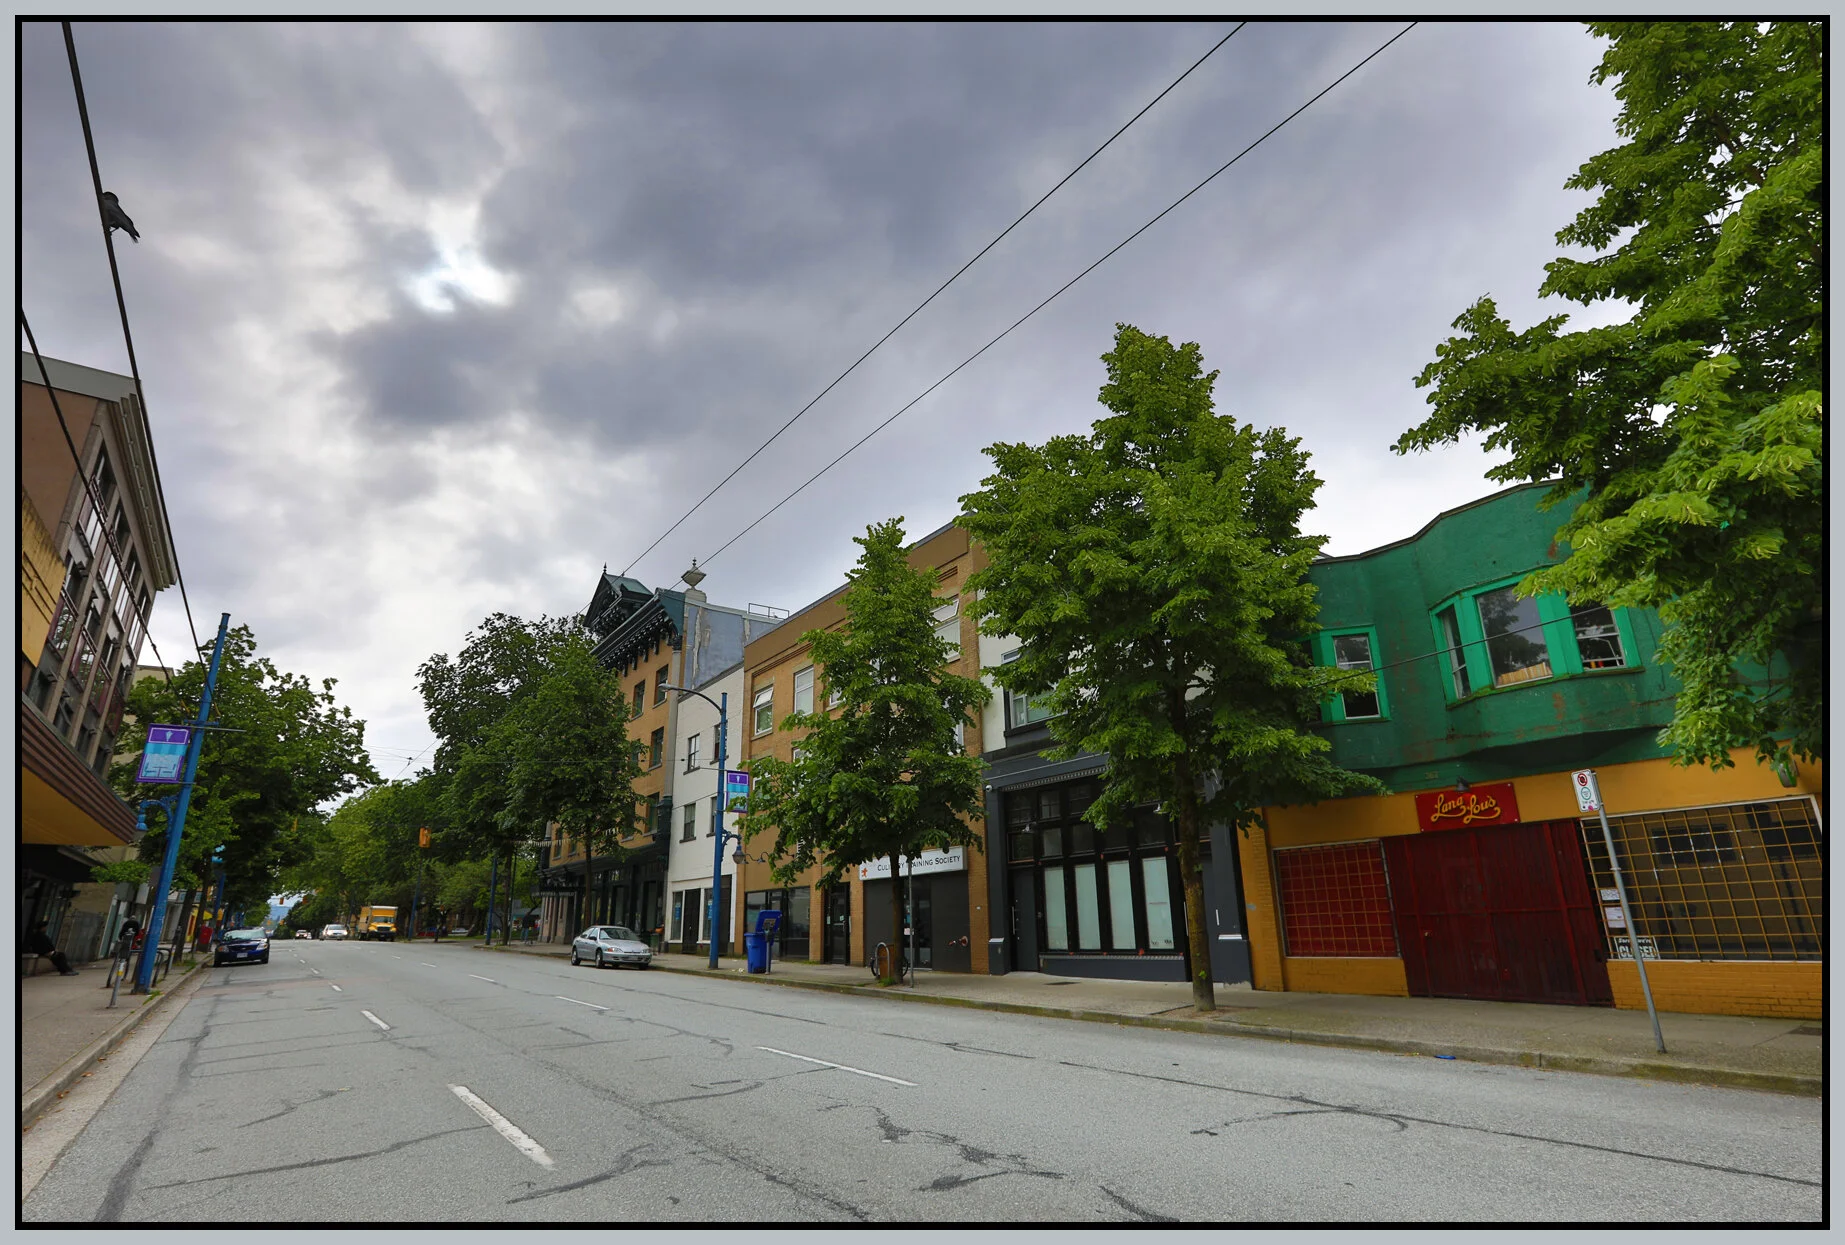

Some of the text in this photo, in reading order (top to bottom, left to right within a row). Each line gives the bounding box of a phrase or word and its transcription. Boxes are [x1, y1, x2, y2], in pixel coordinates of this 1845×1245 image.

[1430, 793, 1501, 824] Lana Lou's
[935, 856, 960, 864] SOCIETY
[1619, 945, 1657, 958] CLSED
